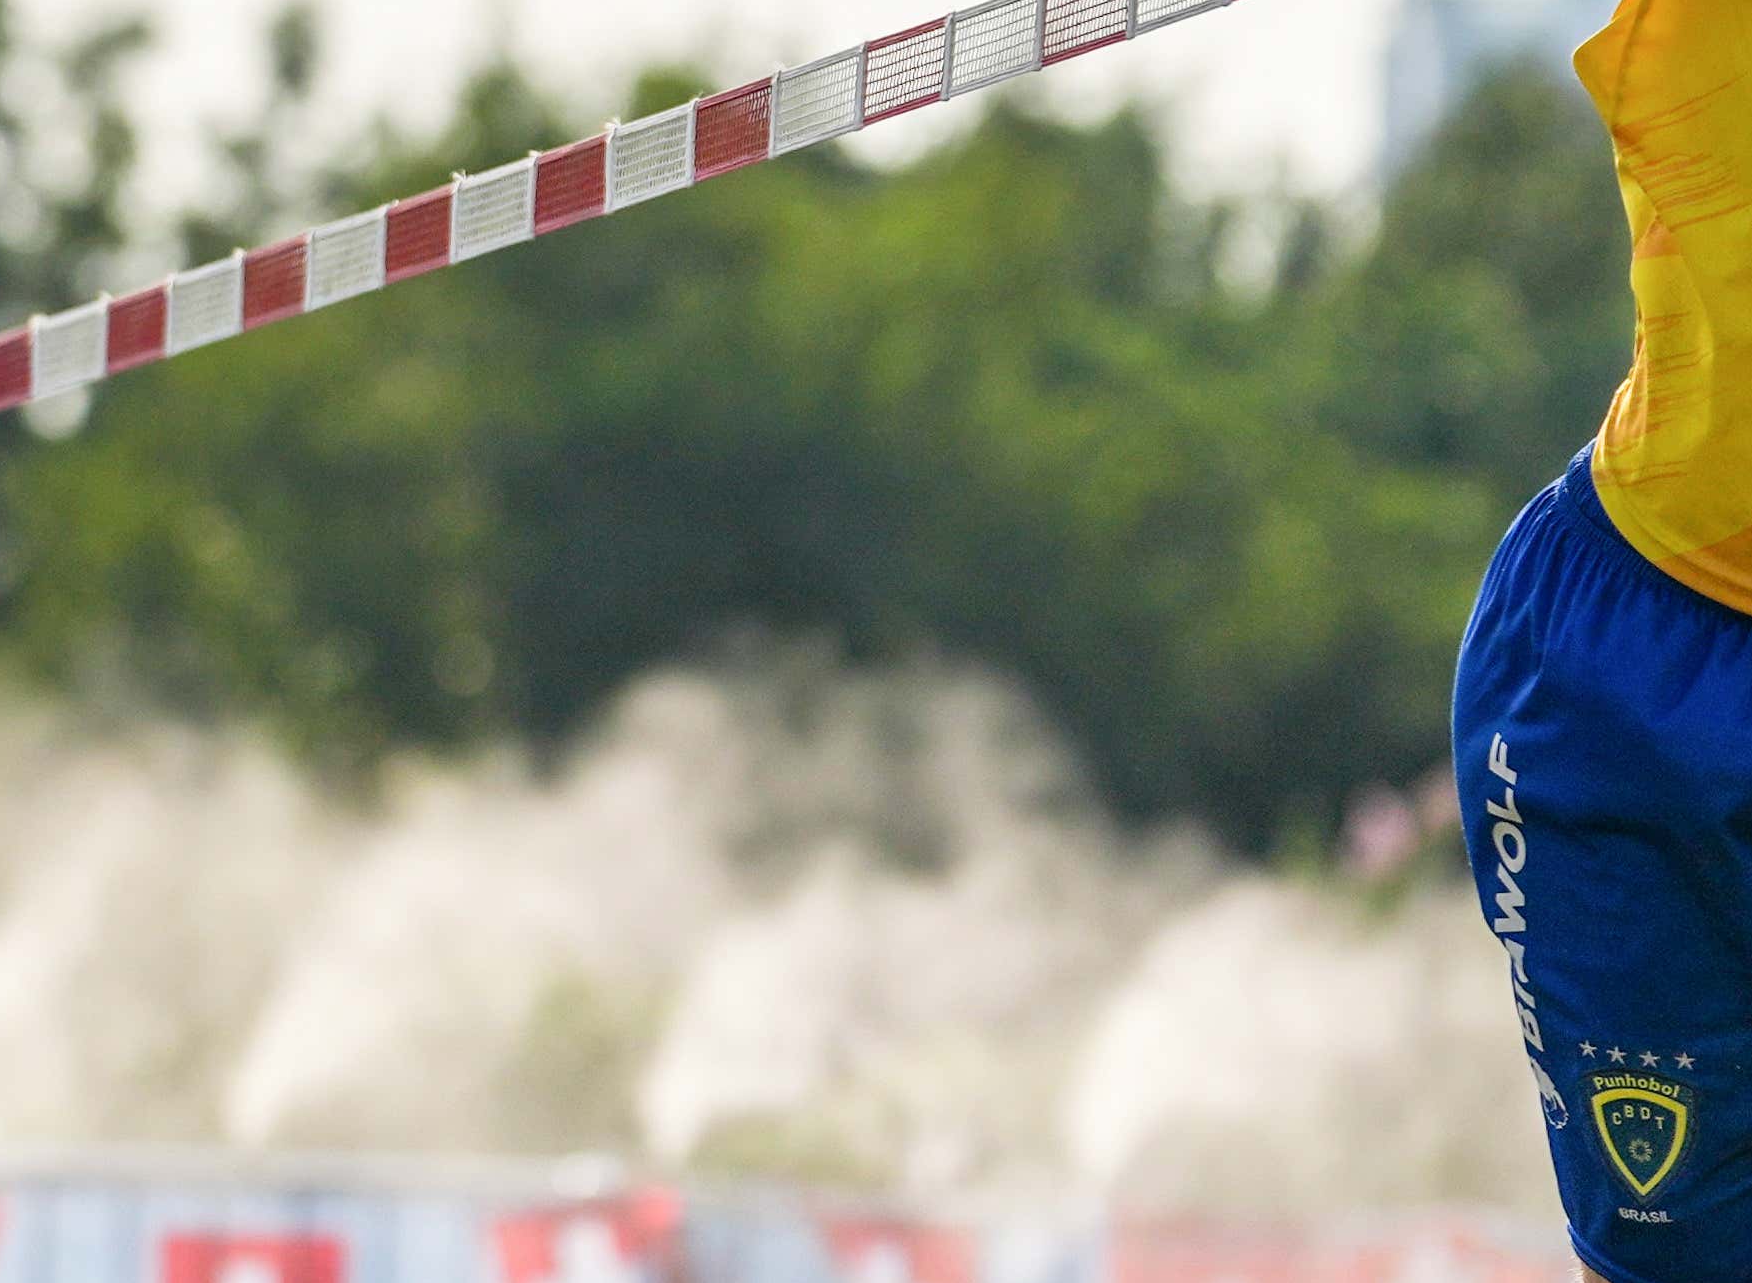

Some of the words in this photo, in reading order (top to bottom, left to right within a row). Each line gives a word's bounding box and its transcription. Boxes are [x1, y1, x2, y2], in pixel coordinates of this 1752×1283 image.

[1592, 1073, 1680, 1099] Punhobol
[1611, 1104, 1665, 1130] CBDT
[1617, 1206, 1676, 1224] BRASIL
